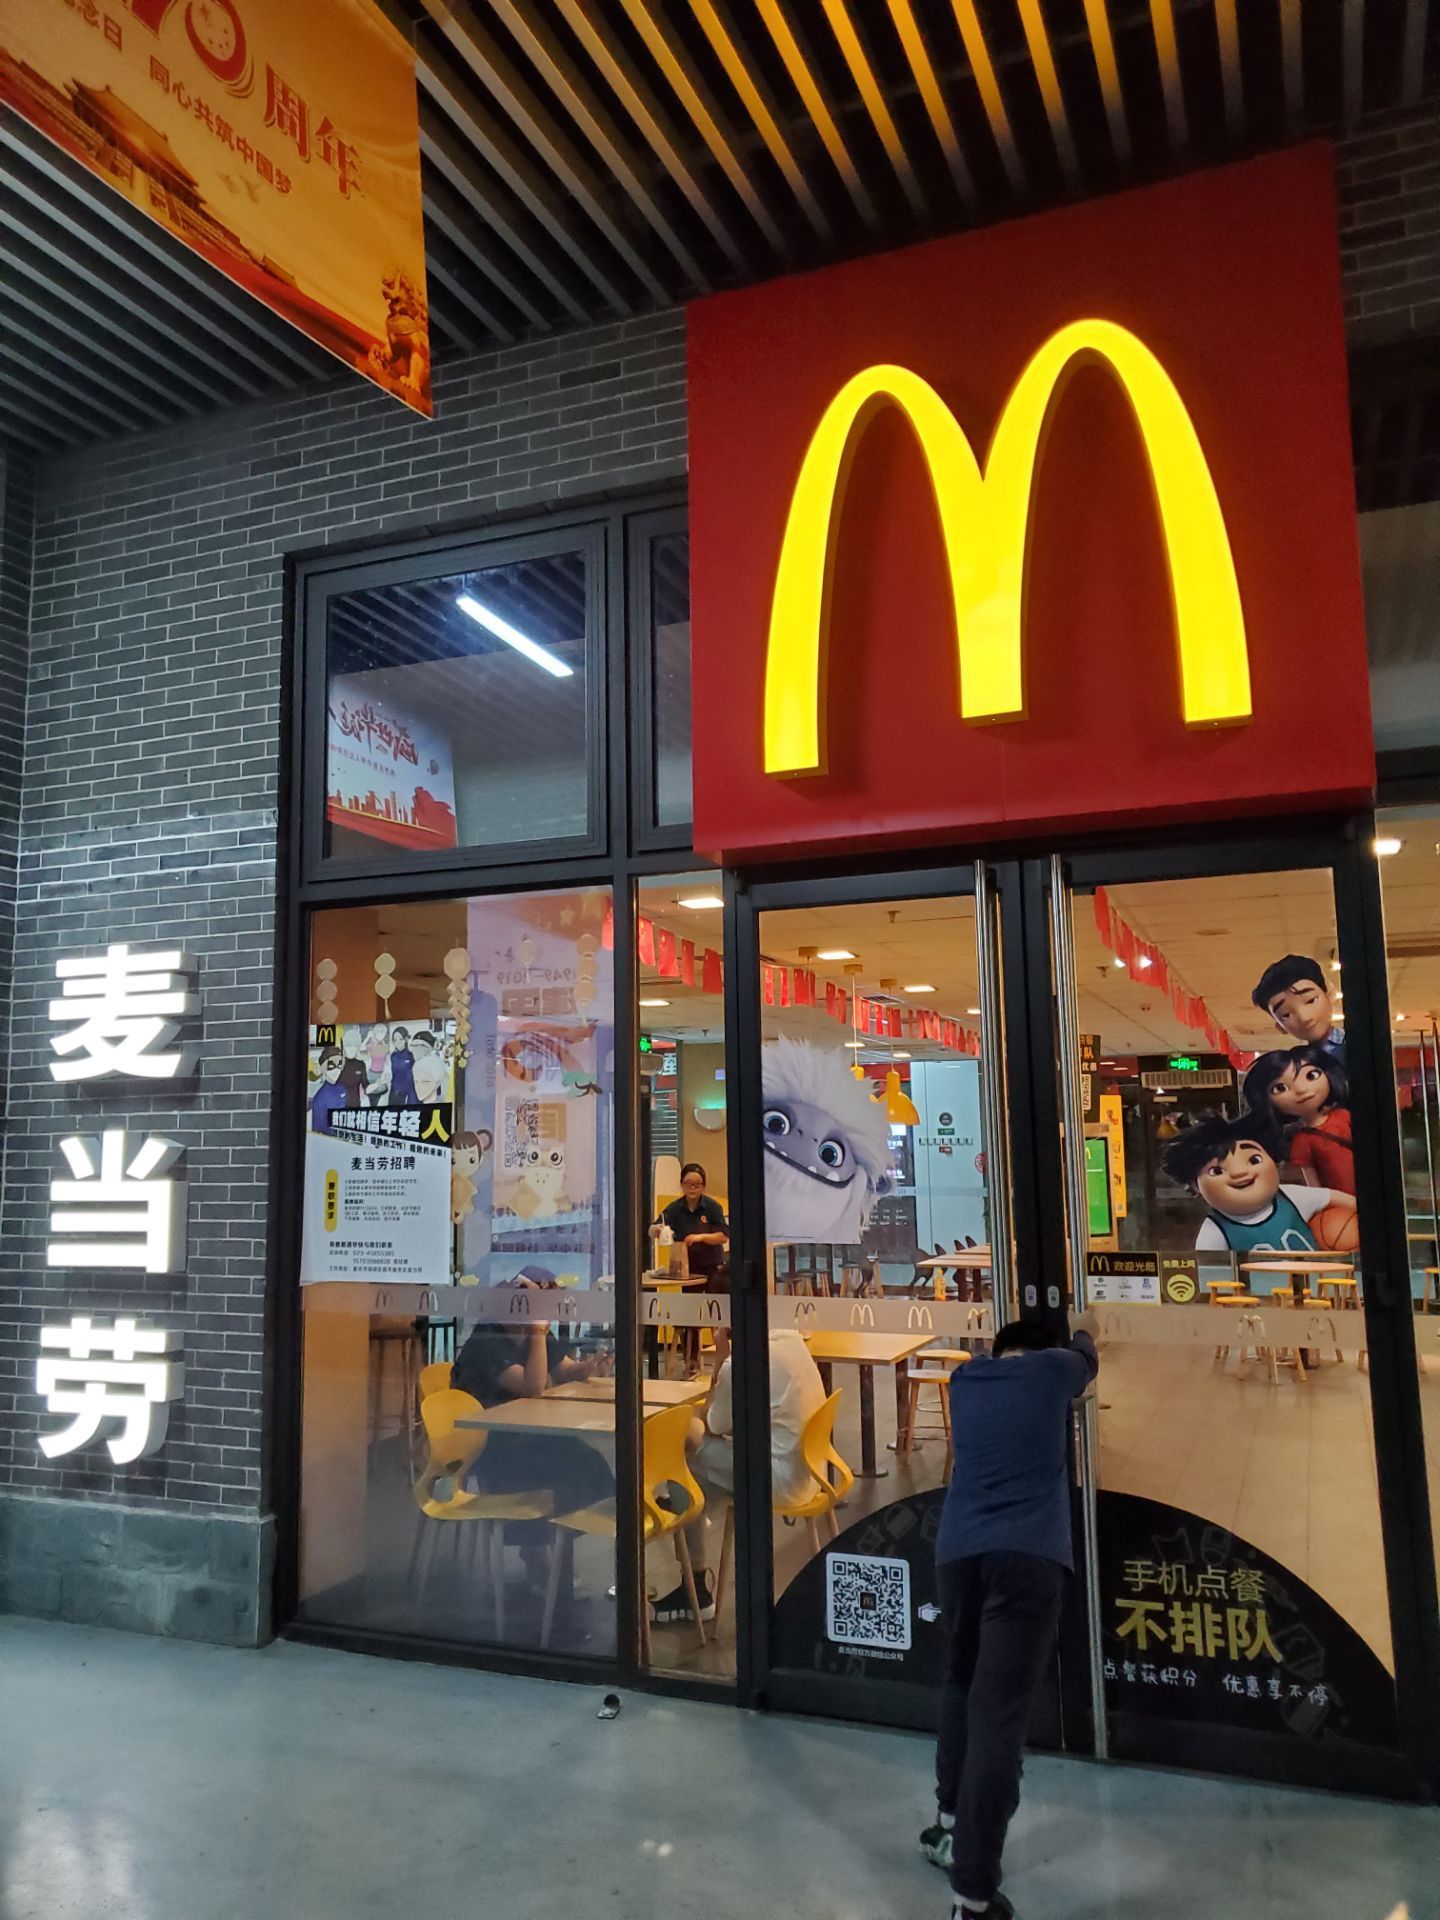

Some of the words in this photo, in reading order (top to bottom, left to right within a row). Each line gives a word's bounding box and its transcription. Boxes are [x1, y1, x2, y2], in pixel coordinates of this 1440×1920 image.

[149, 54, 294, 196] 同心共筑中国梦
[763, 318, 1253, 775] M
[331, 1109, 450, 1143] 我们就相信年轻人
[351, 1156, 416, 1171] 麦当劳招聘
[36, 944, 190, 1466] 麦当劳
[1113, 1261, 1156, 1273] 欢迎光临
[1162, 1259, 1196, 1269] 免费上网
[1123, 1559, 1266, 1604] 手机点餐
[1114, 1598, 1284, 1664] 不排队
[1103, 1660, 1198, 1688] 点餐获积分
[1222, 1674, 1329, 1707] 优惠享不停
